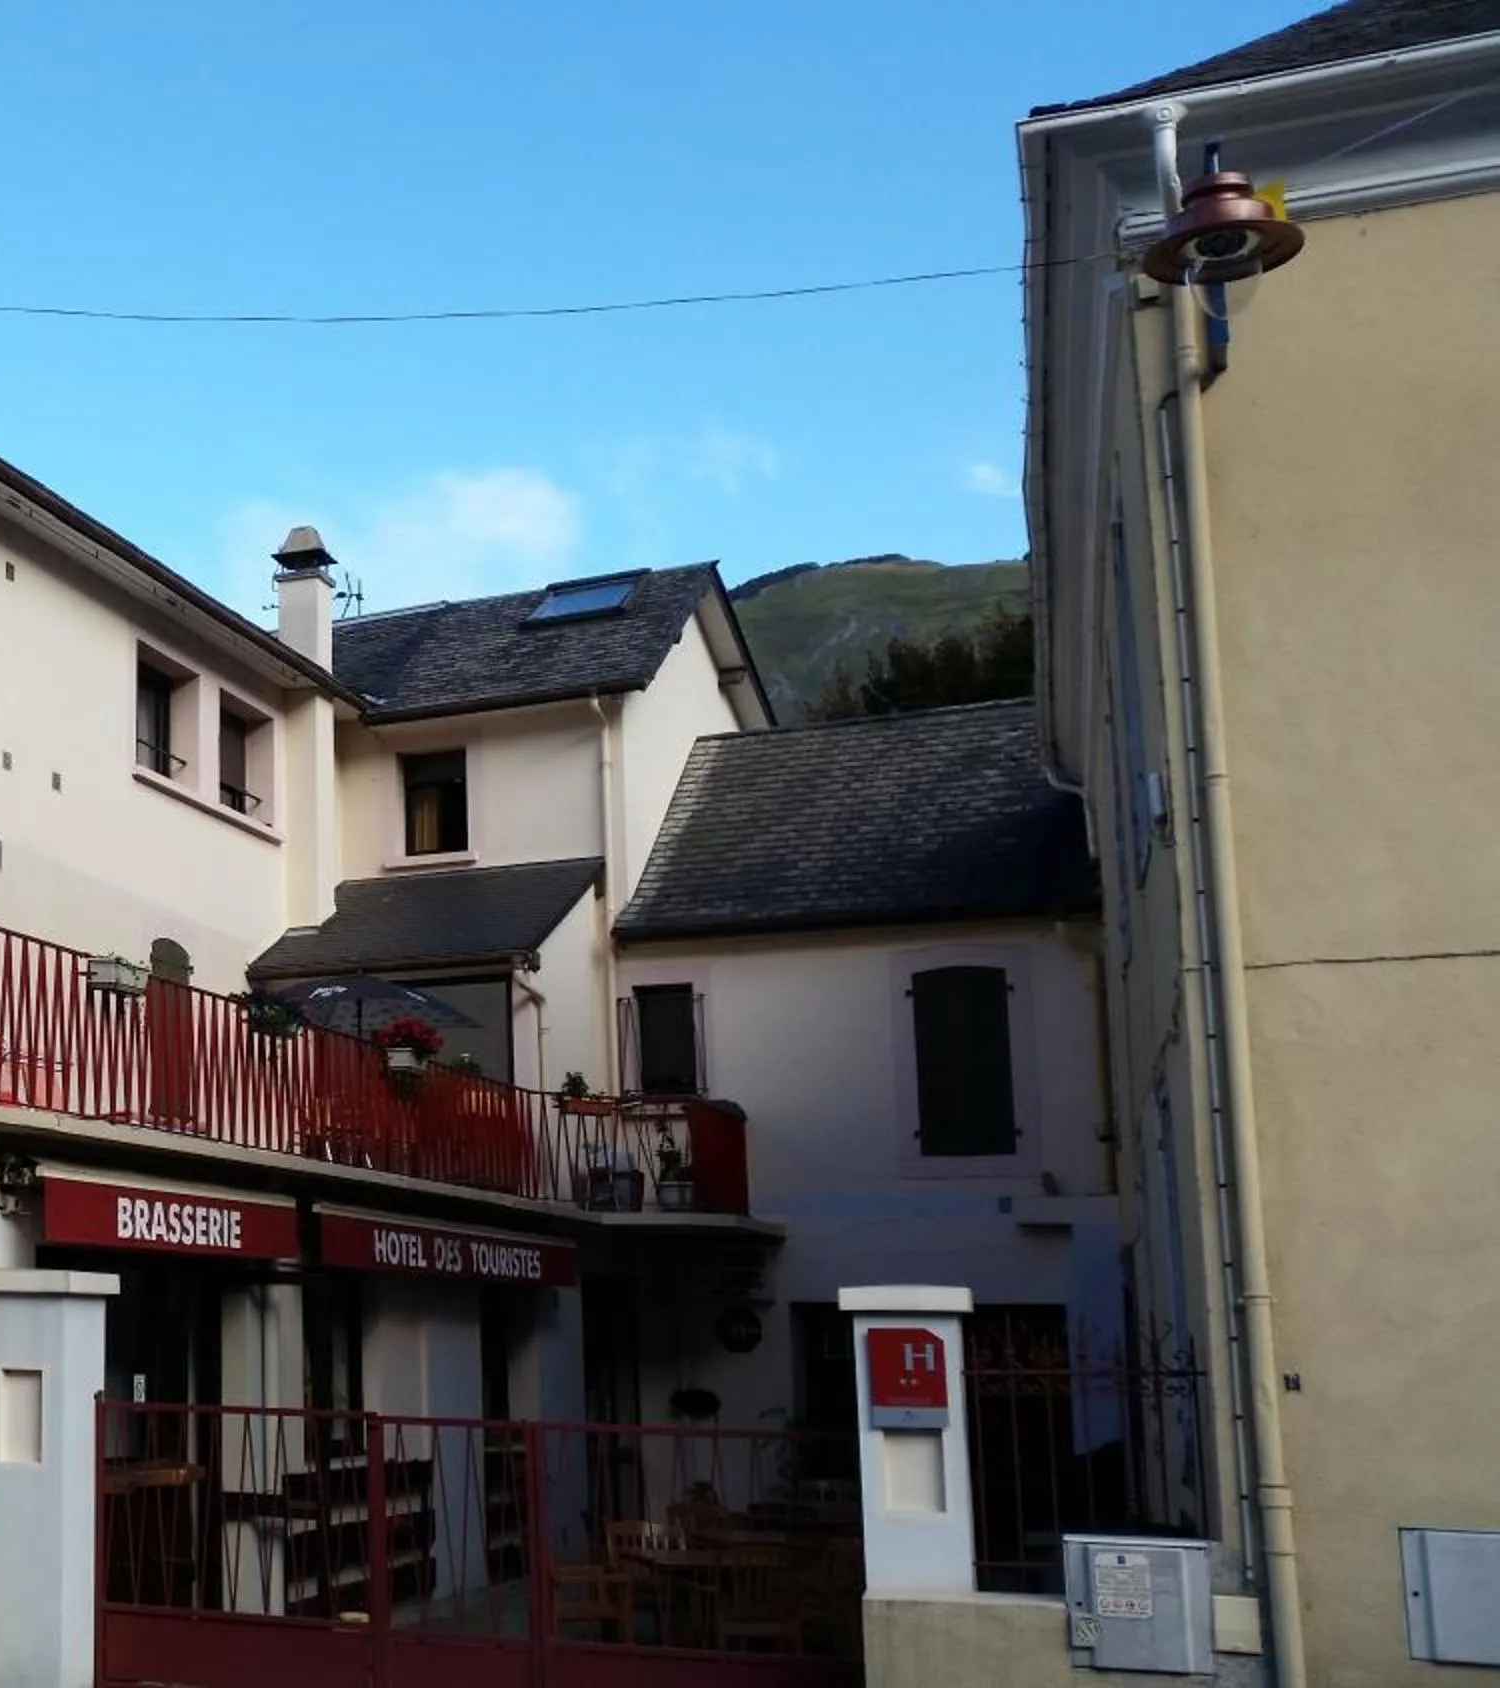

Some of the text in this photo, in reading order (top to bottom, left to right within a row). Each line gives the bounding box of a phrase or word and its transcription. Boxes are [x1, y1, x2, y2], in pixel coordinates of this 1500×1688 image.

[117, 1197, 242, 1249] BRASSERIE
[373, 1229, 542, 1280] HOTEL DES TOURISTES
[904, 1343, 936, 1371] H
